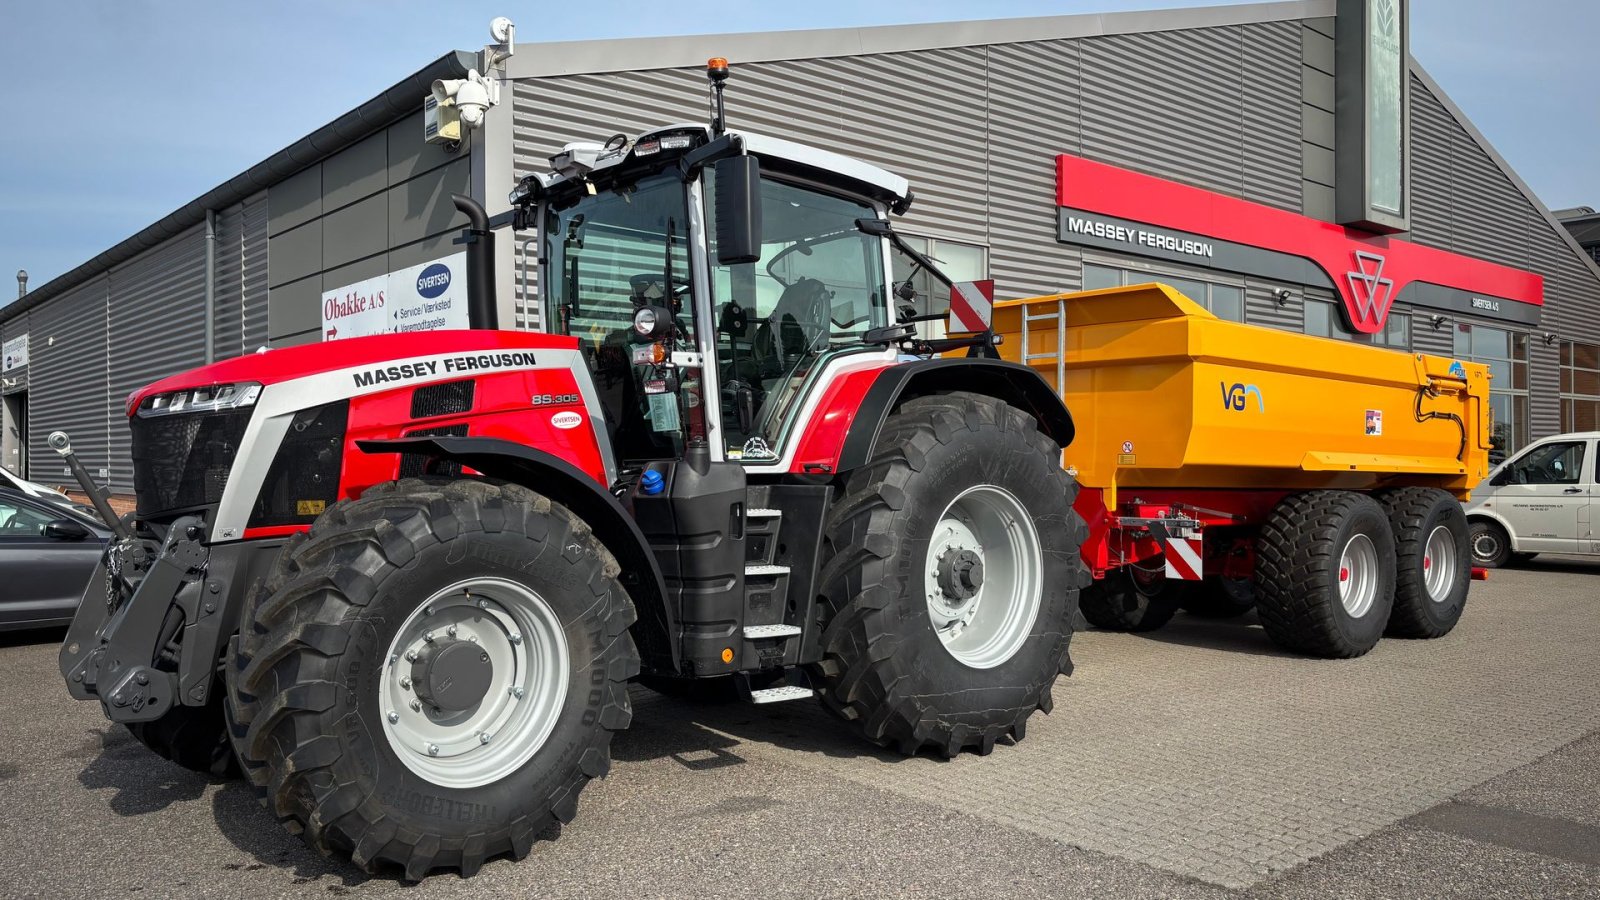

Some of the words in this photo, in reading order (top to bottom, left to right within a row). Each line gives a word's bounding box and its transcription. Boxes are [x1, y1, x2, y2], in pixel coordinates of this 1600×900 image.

[1068, 217, 1135, 243] MASSEY
[1138, 231, 1213, 257] FERGUSON
[418, 272, 449, 290] SIVERTSEN
[324, 291, 366, 321] Øbakke
[368, 290, 384, 311] A/S
[353, 360, 437, 388] MASSEY
[443, 352, 537, 373] FERGUSON
[532, 394, 579, 405] 8S.305
[553, 416, 580, 424] SIVERTSEN
